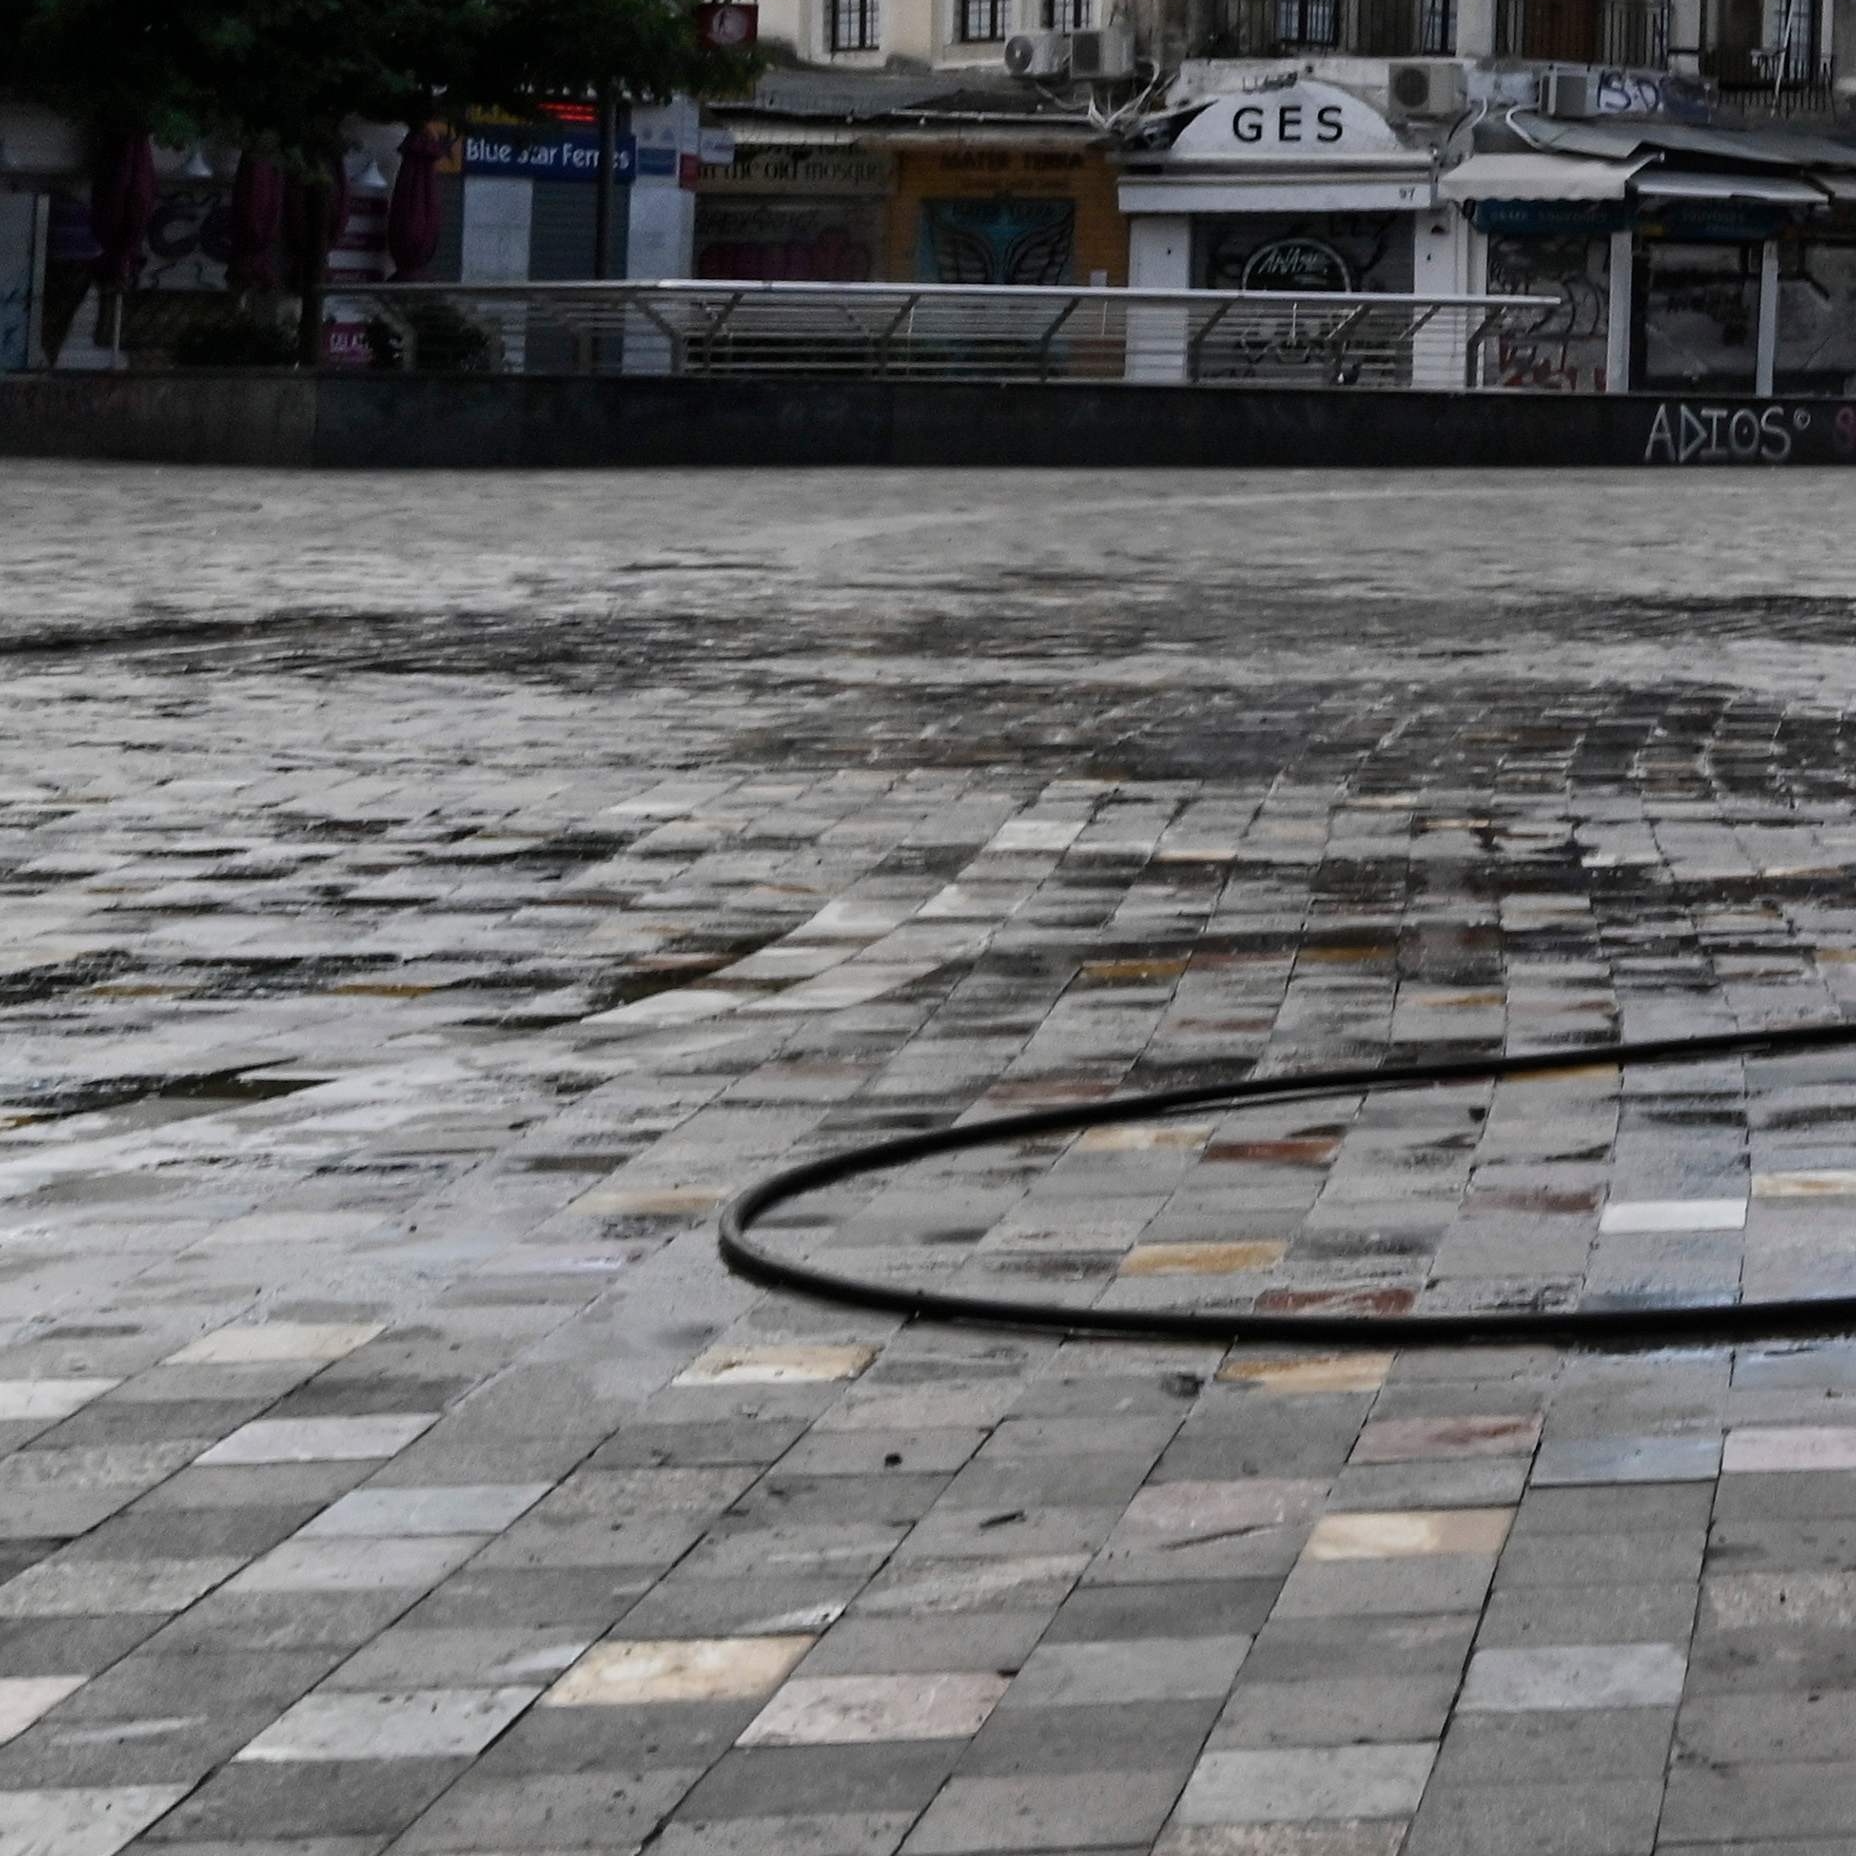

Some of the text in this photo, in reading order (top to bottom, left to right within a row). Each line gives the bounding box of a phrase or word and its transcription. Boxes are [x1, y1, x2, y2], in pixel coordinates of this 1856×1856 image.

[1232, 106, 1343, 142] GES
[464, 137, 513, 164] Blue
[561, 143, 632, 170] Ferres
[765, 154, 799, 180] old
